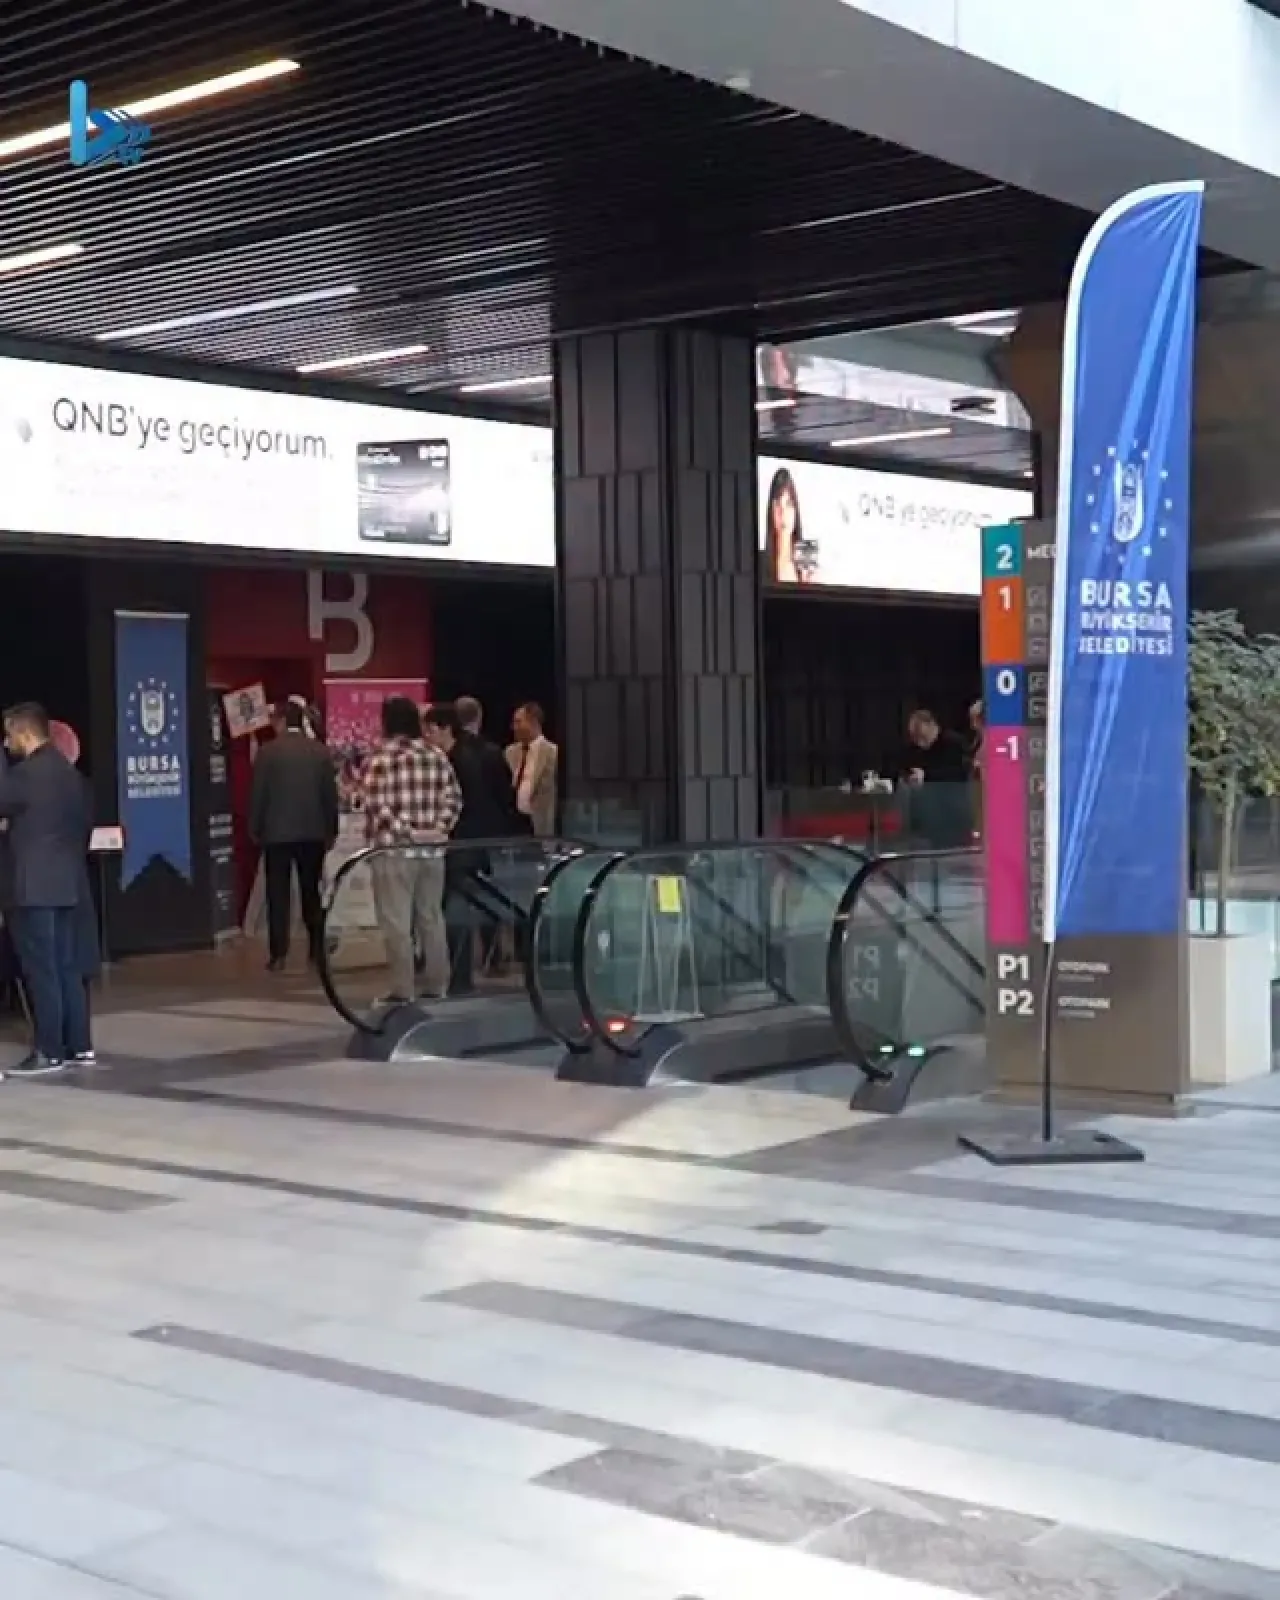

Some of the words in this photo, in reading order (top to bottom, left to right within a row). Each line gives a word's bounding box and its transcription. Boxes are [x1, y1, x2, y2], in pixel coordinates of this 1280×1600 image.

[53, 397, 170, 449] QNB'ye
[179, 417, 334, 461] geçiyorum.
[996, 544, 1014, 570] 2
[998, 585, 1011, 610] 1
[1080, 578, 1171, 608] BURSA
[996, 670, 1016, 695] 0
[995, 736, 1019, 761] -1
[998, 953, 1030, 980] P1
[998, 987, 1035, 1015] P2
